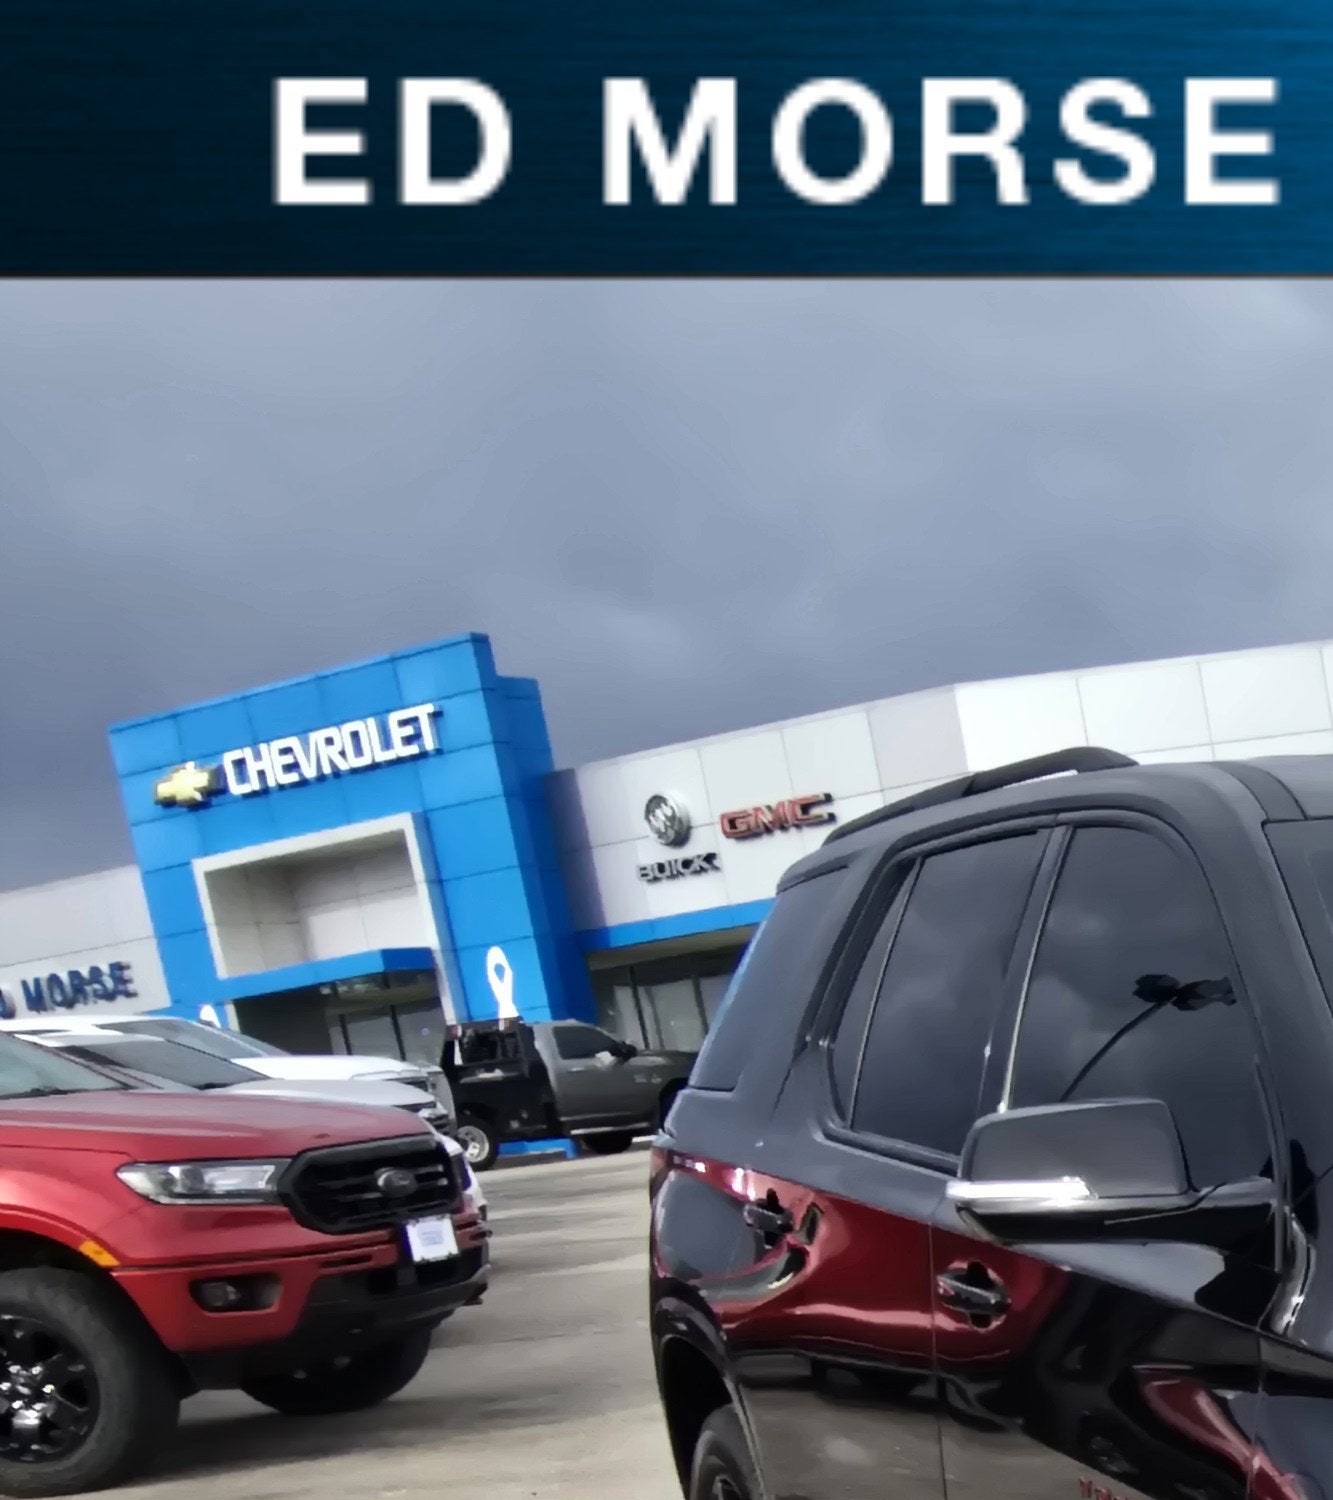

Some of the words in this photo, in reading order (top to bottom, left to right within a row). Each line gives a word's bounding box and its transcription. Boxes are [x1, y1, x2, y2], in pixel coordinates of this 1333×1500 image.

[223, 703, 437, 796] CHEVROLET
[720, 794, 835, 840] GMC
[638, 853, 722, 882] BUICK
[21, 962, 138, 1012] MORSE
